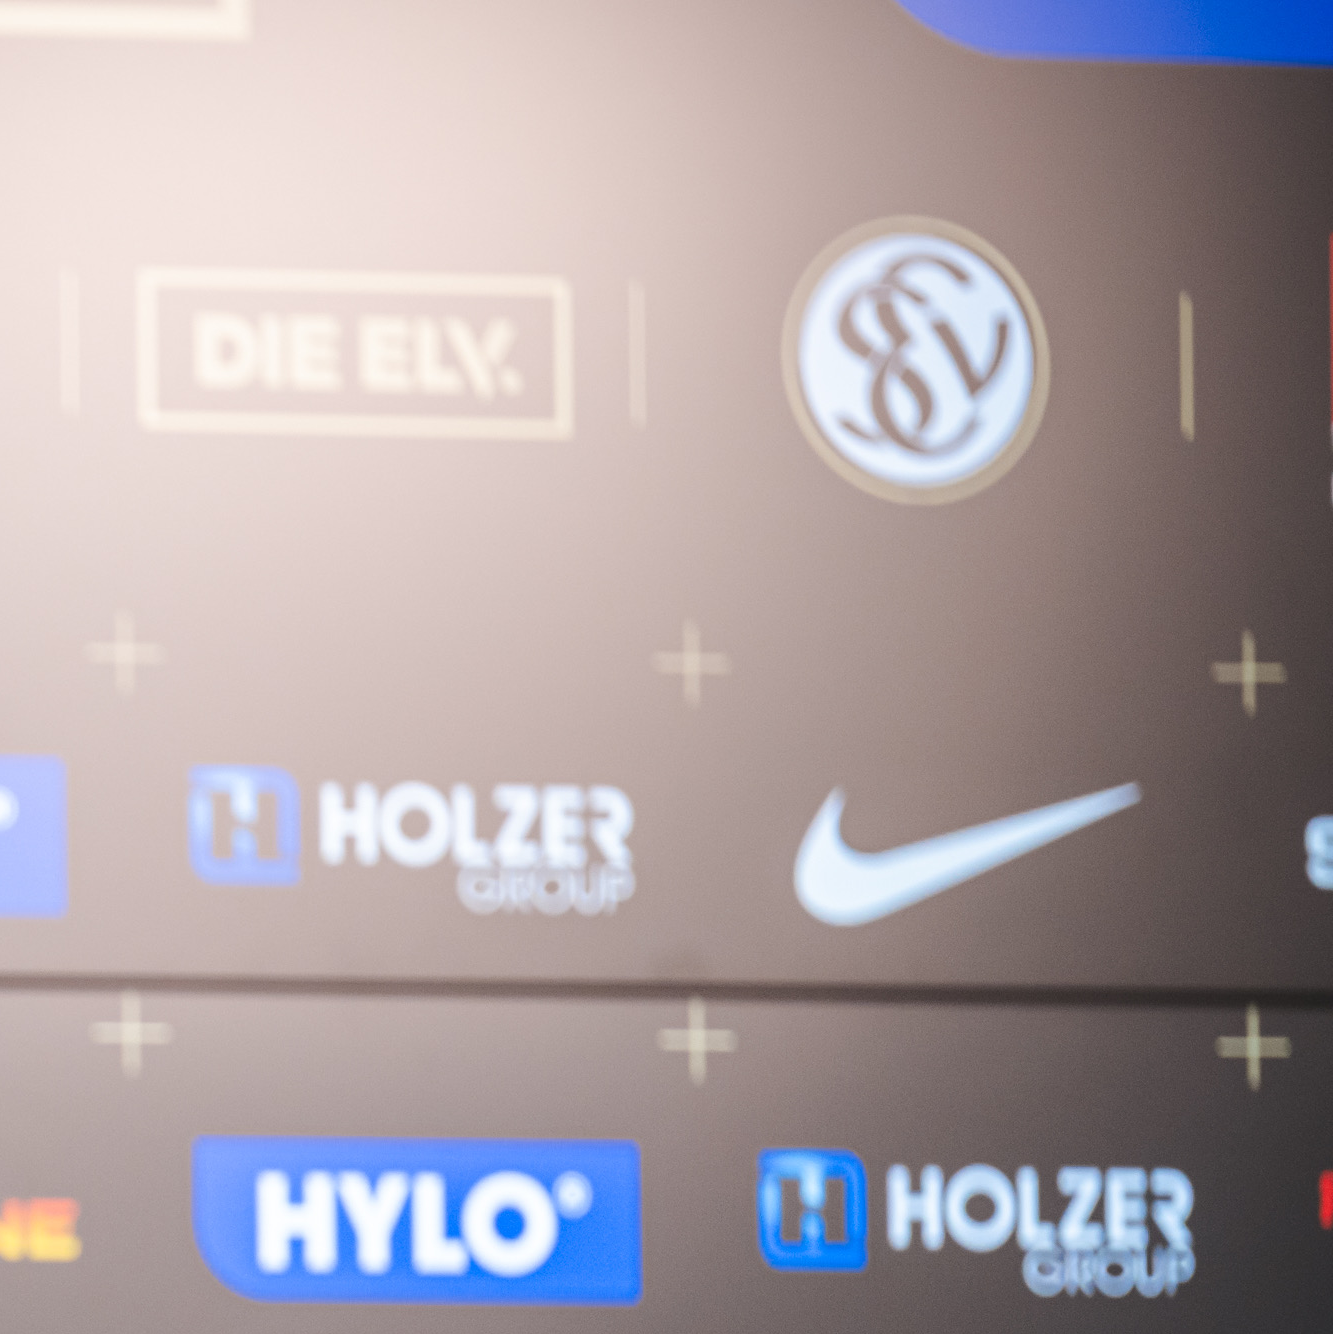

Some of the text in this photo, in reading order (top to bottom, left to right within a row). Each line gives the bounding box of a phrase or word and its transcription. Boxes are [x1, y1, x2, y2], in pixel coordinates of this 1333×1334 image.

[192, 309, 345, 391] DIE
[318, 779, 634, 870] HOLZER
[456, 866, 634, 917] GROUP
[886, 1164, 1195, 1257] HOLZER
[1021, 1248, 1195, 1299] GROUP
